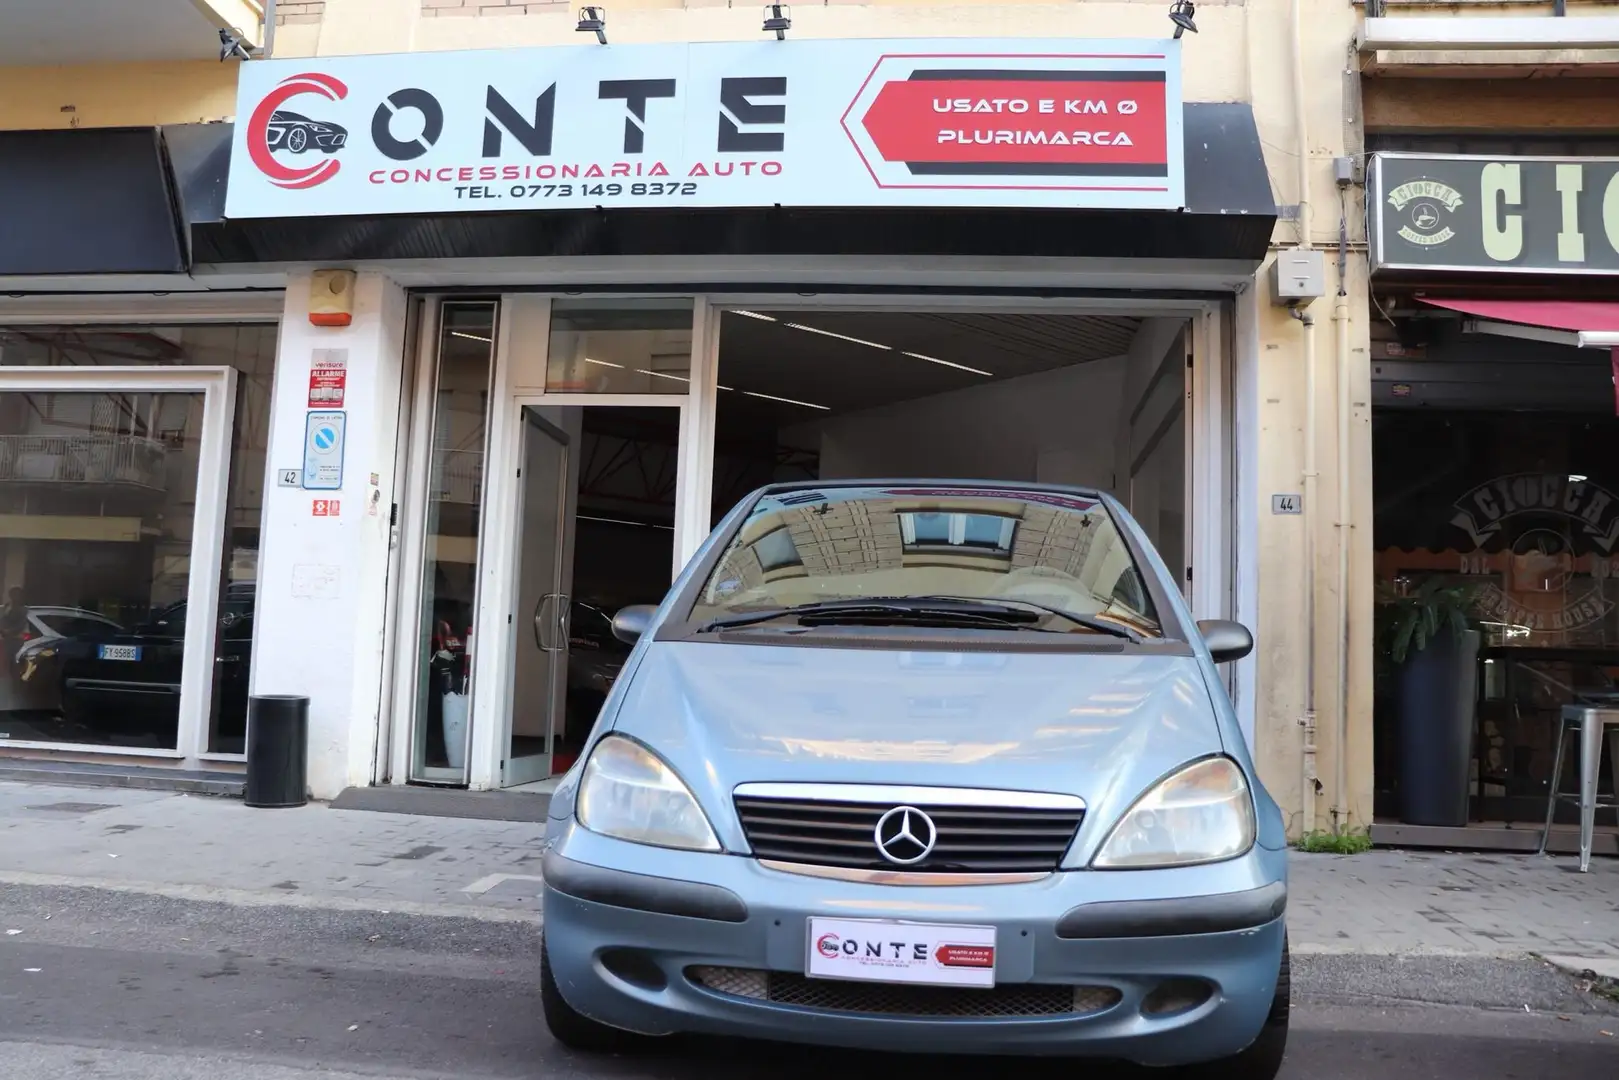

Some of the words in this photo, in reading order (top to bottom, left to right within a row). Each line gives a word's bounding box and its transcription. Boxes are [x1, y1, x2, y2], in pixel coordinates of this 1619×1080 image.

[932, 98, 1029, 113] USATO
[1038, 99, 1055, 113] E
[1064, 100, 1108, 114] KM
[246, 73, 788, 189] CONTE
[937, 129, 1134, 146] PLURIMARCA
[369, 162, 670, 184] CONCESSIONARIA
[687, 161, 783, 177] AUTO
[454, 185, 502, 199] TEL.
[510, 184, 573, 198] 0773
[581, 183, 623, 197] 149
[630, 182, 698, 196] 8372
[1397, 182, 1452, 201] CIOCCA
[284, 472, 296, 484] 42
[1280, 498, 1293, 510] 44
[1473, 475, 1611, 525] CIOCCA
